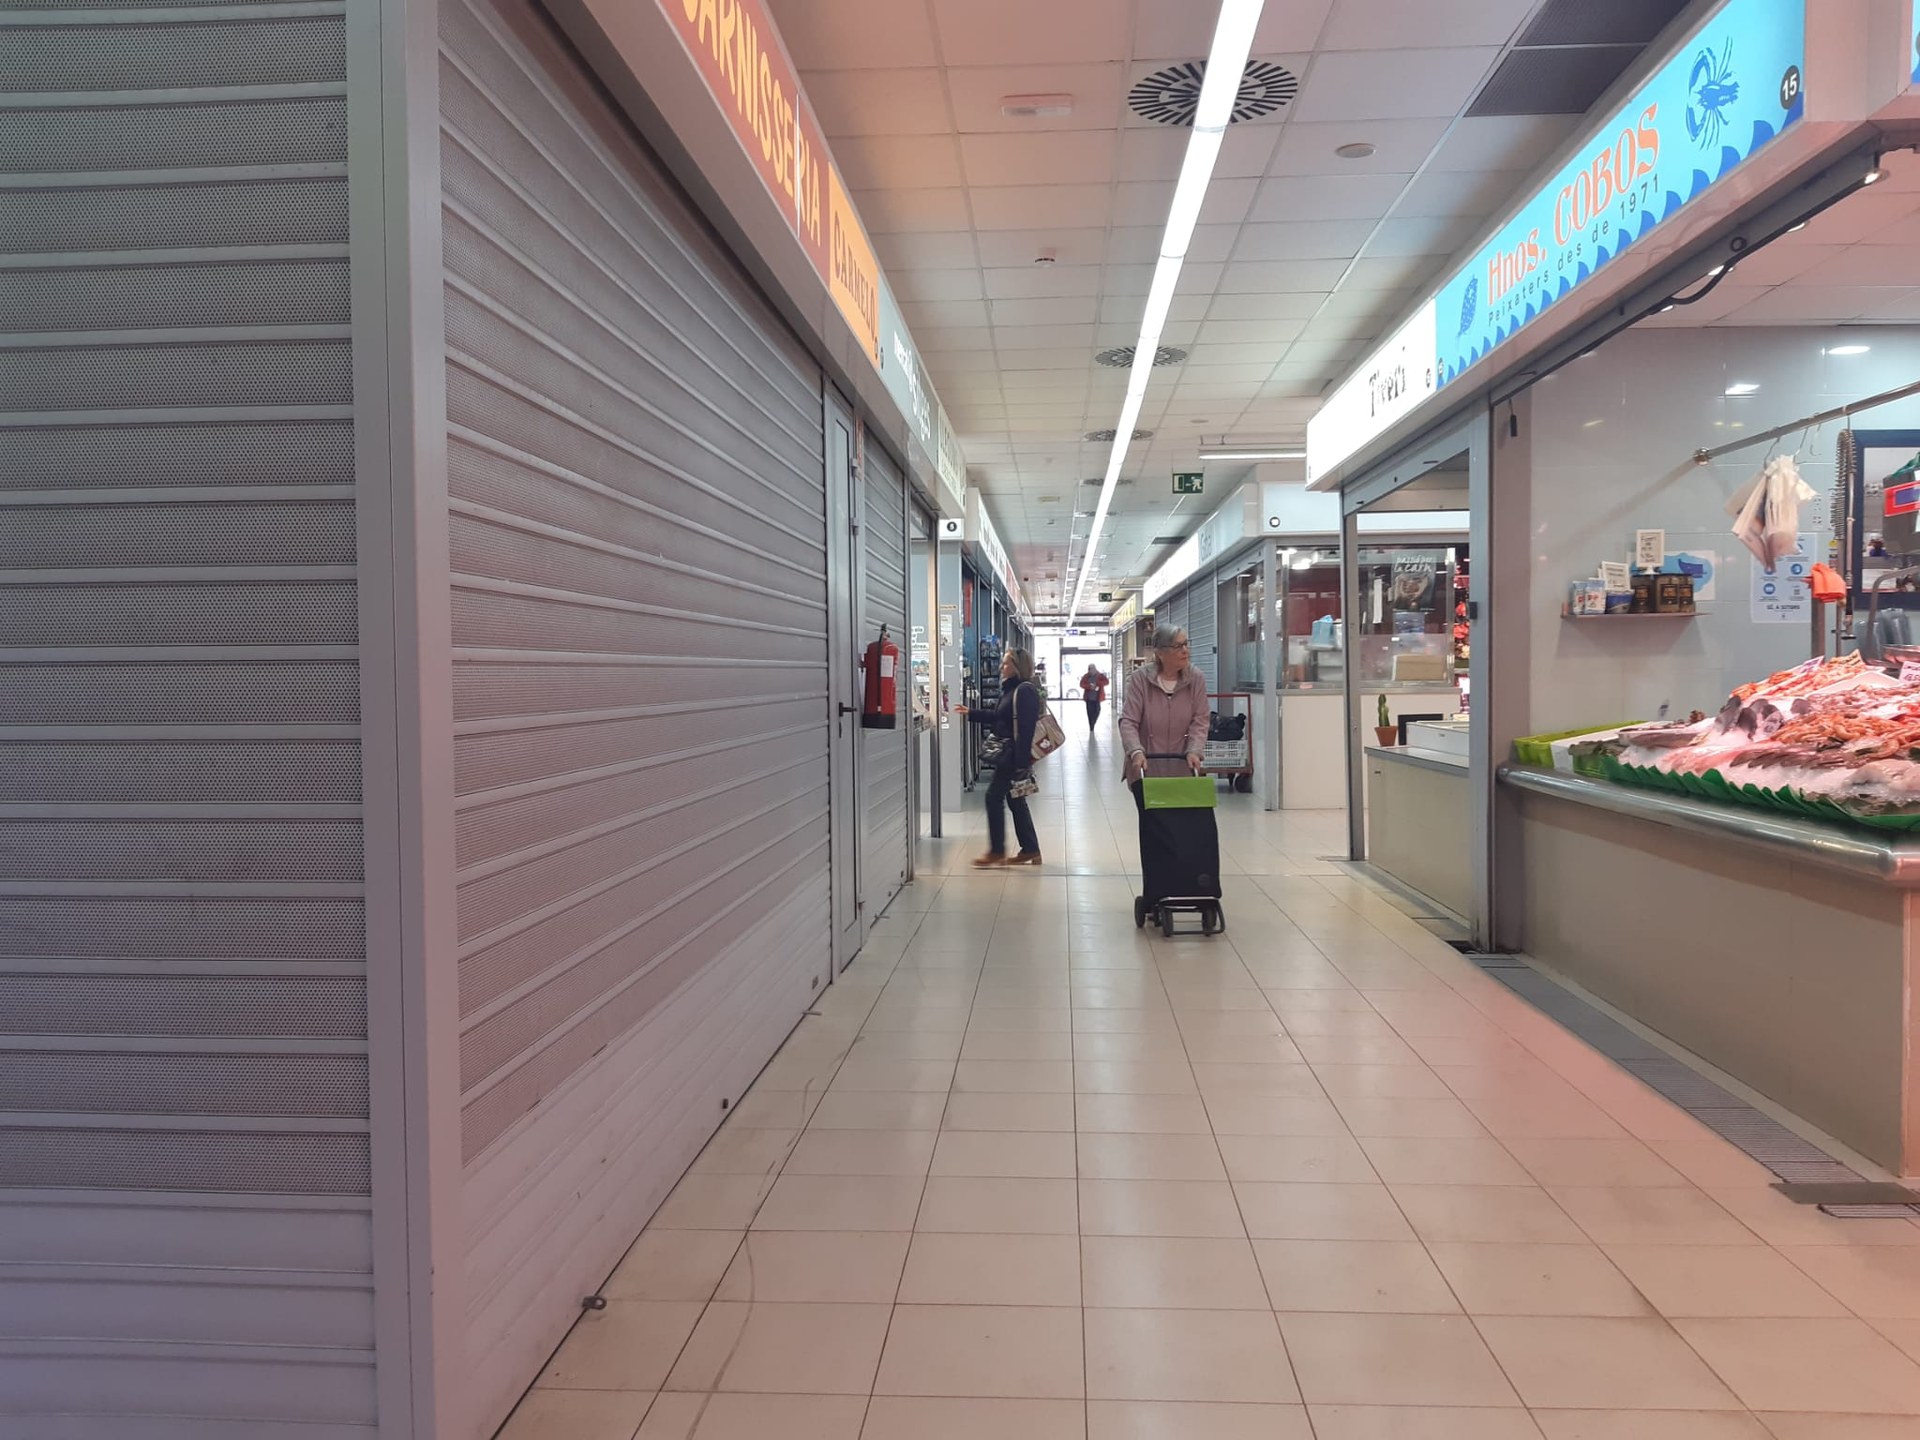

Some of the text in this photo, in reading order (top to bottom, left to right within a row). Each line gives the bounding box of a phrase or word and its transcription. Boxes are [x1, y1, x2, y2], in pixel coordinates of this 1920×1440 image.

[682, 0, 822, 248] ARNISSERIA
[1782, 73, 1798, 101] 15
[1488, 102, 1660, 306] Hnos. COBOS
[1488, 172, 1660, 327] Peixaters des de 1971
